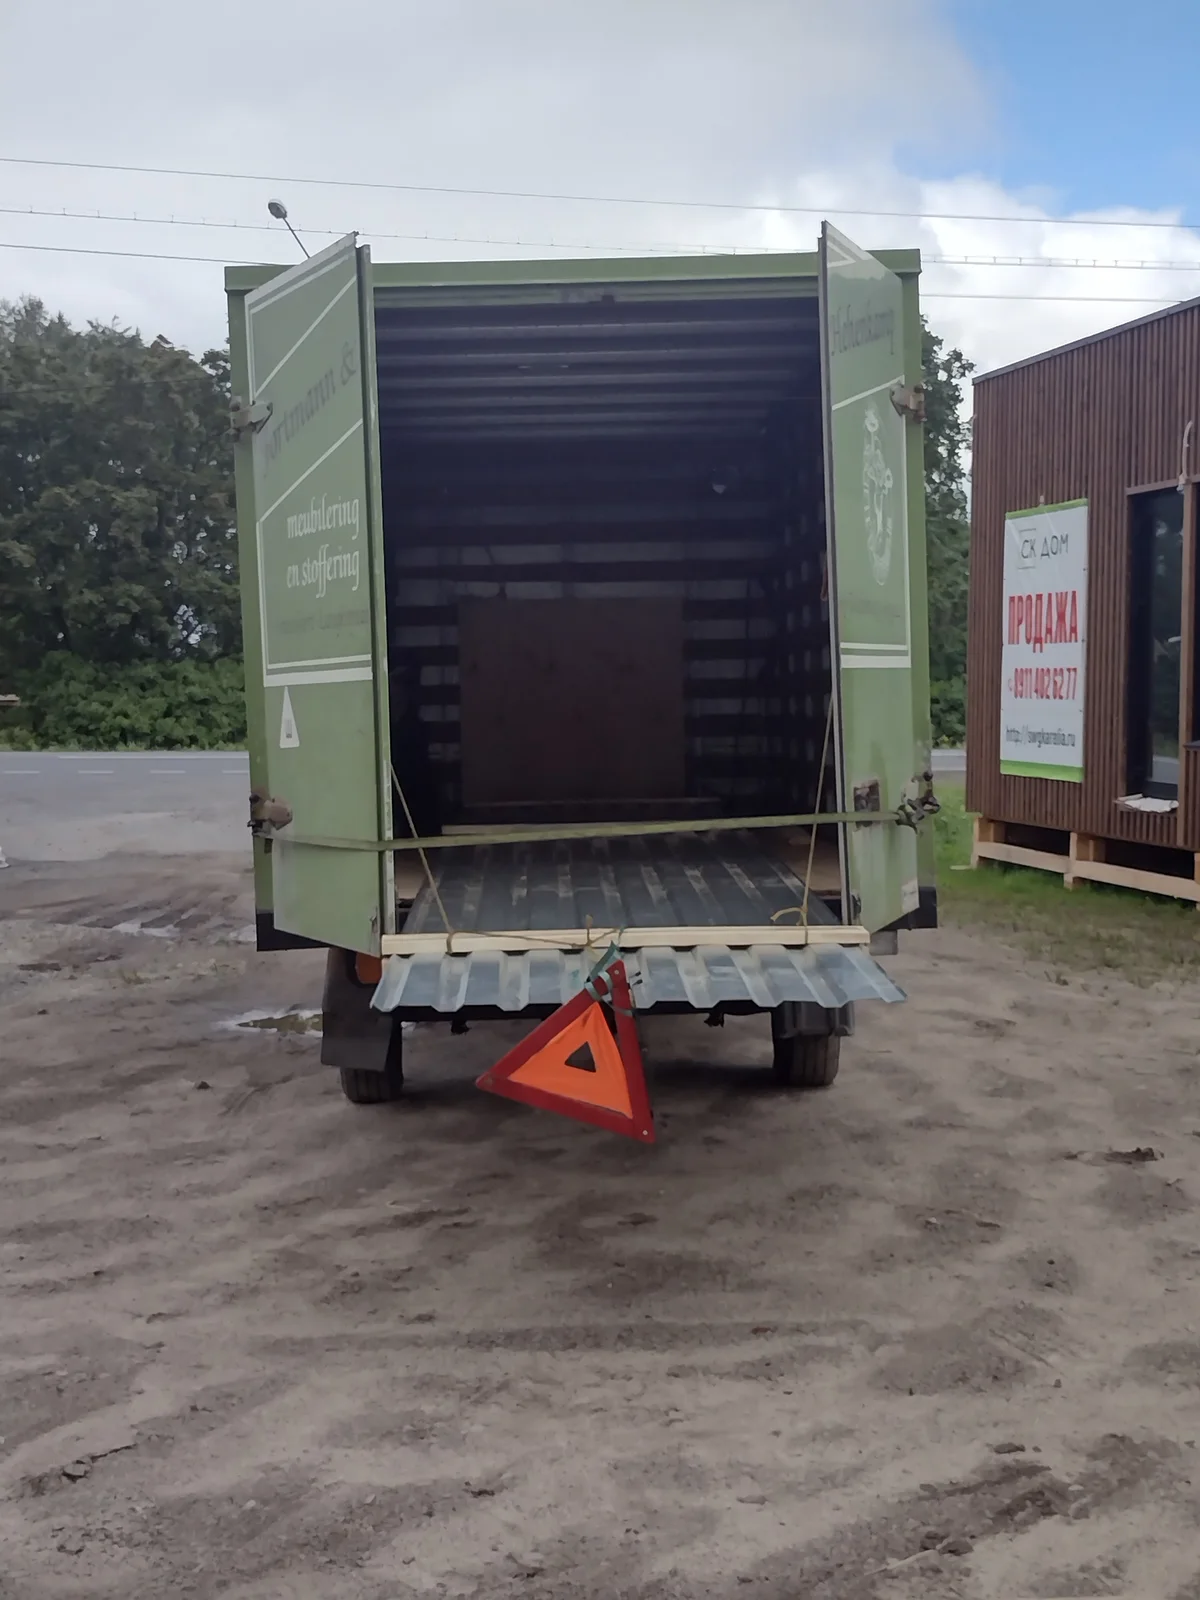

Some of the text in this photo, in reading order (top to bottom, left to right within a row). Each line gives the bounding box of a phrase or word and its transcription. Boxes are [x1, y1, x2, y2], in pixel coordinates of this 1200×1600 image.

[287, 493, 360, 541] meubilering
[1020, 533, 1069, 560] СК ДОМ
[286, 544, 360, 599] en stoffering
[1008, 591, 1078, 653] ПРОДАЖА
[1066, 667, 1078, 700] 77
